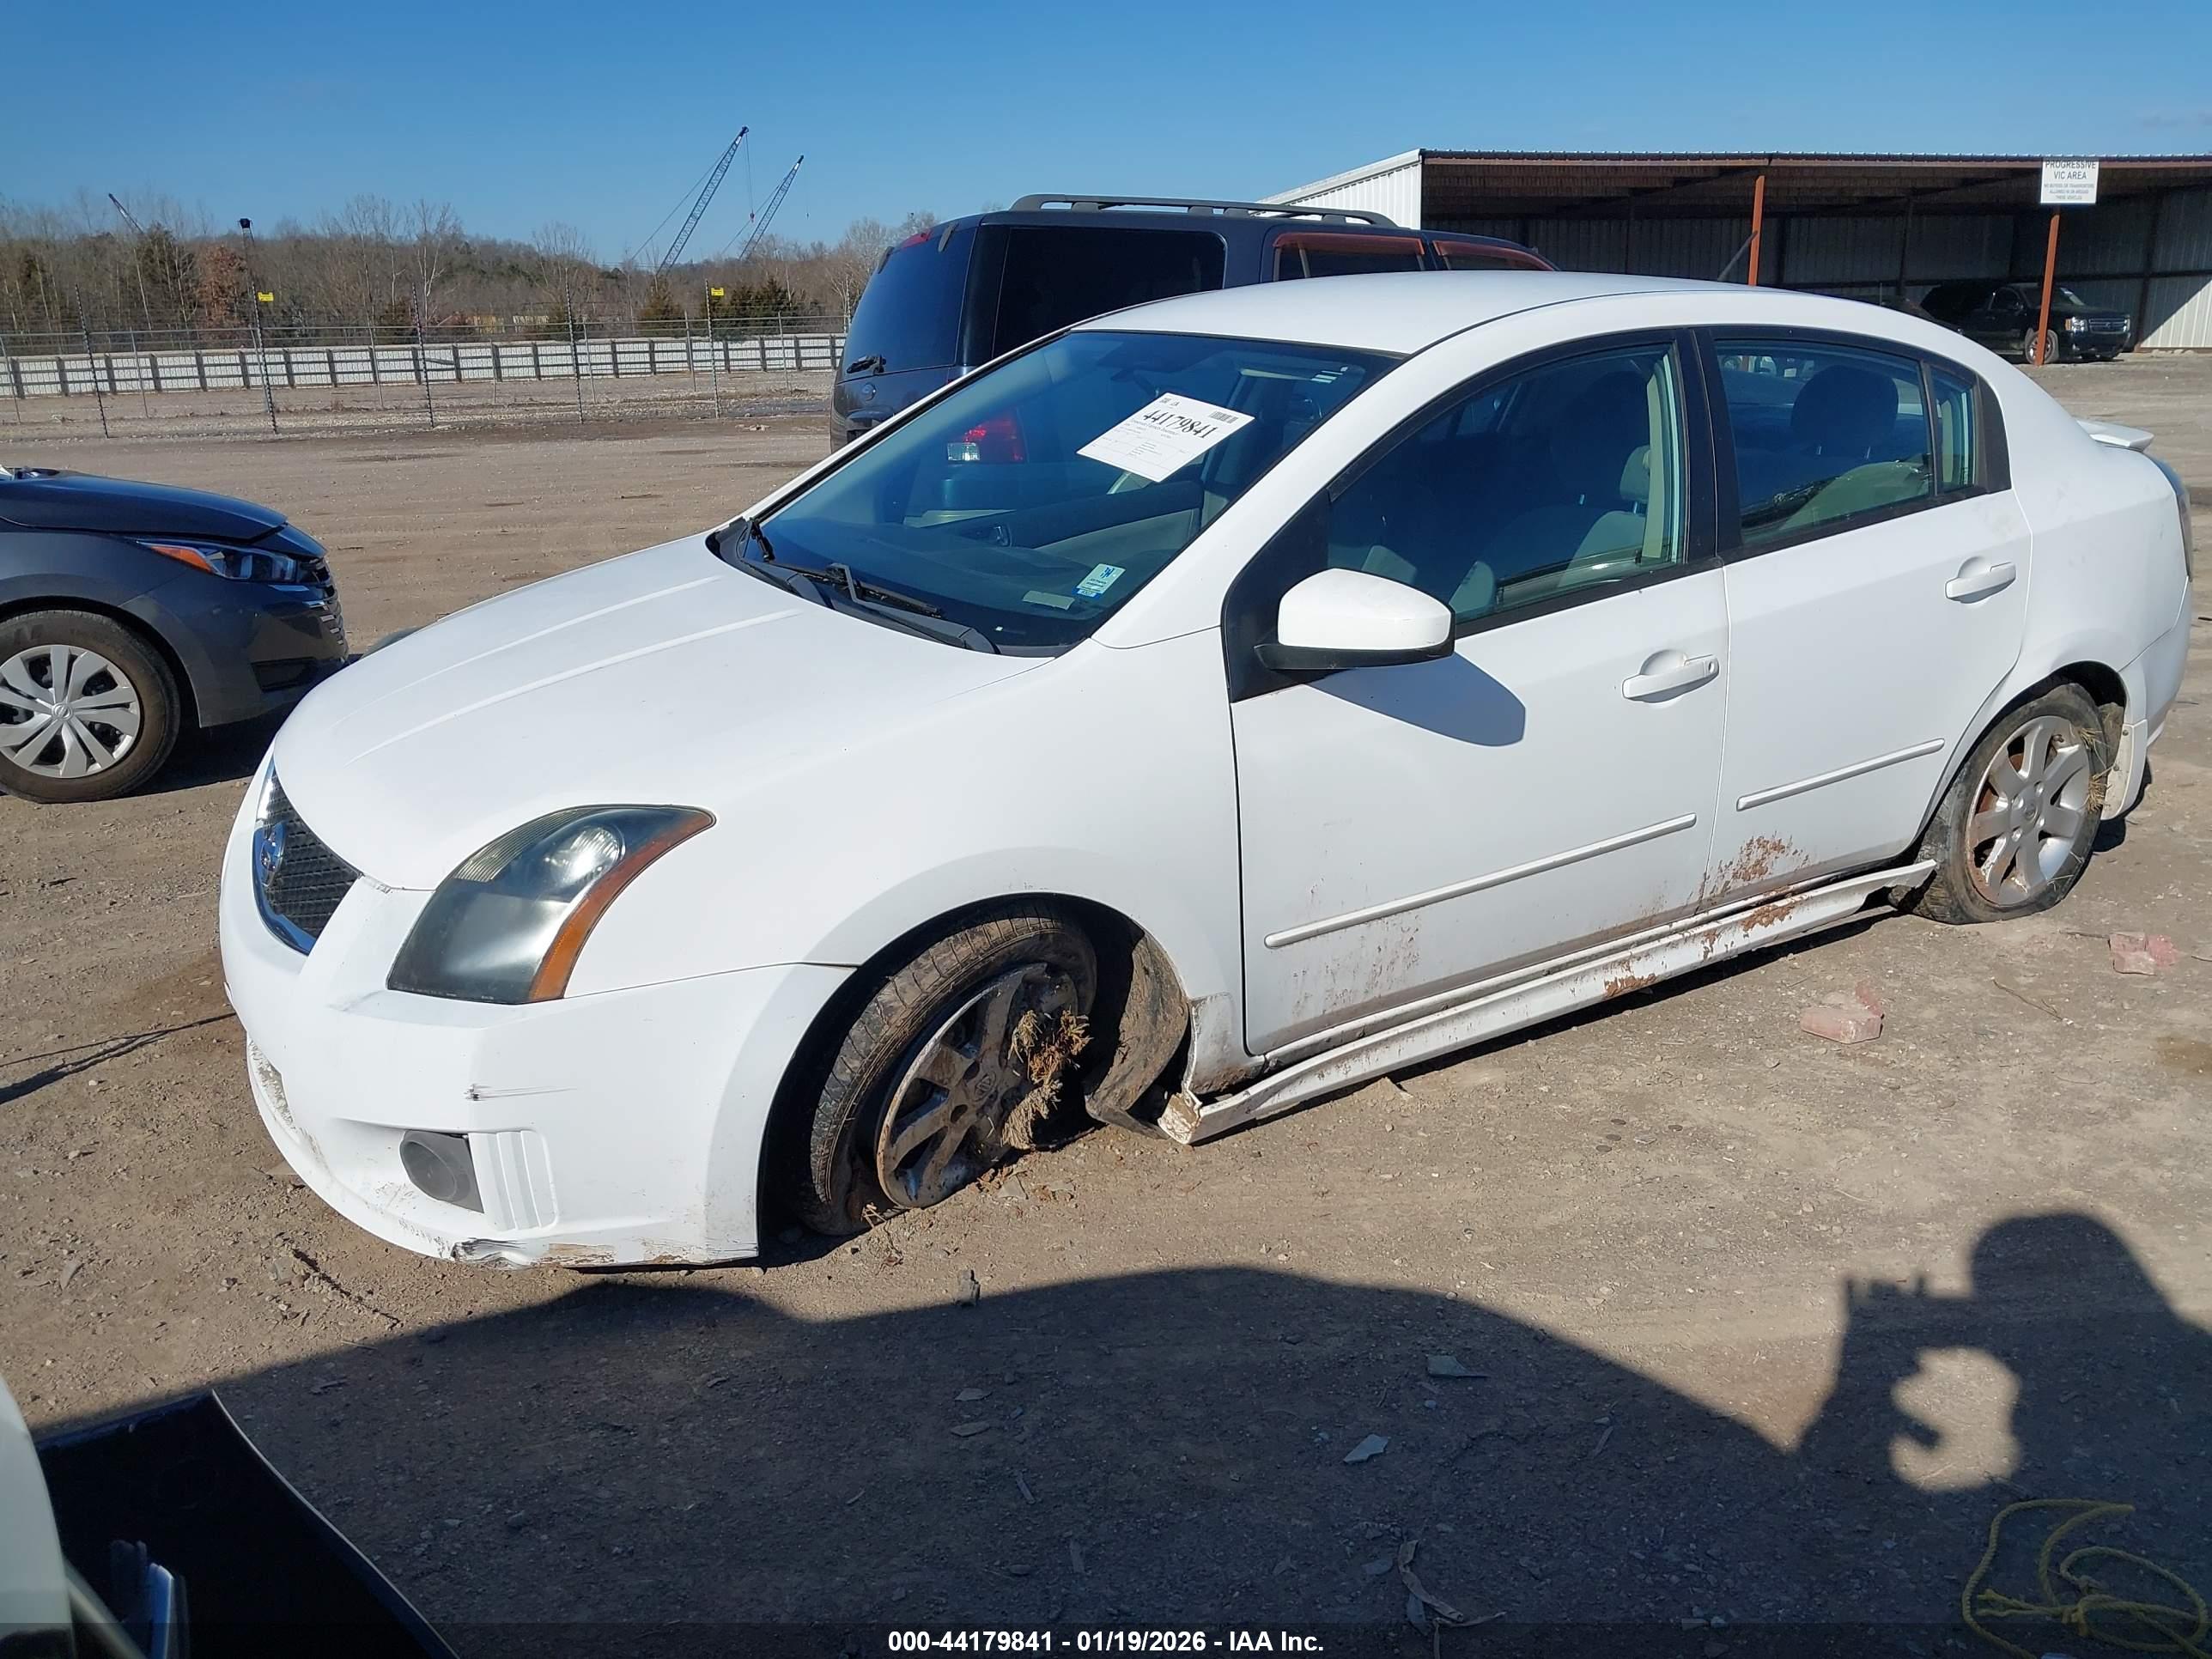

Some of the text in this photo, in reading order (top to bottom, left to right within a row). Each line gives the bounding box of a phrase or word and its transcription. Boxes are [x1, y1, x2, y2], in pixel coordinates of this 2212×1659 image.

[2045, 160, 2096, 169] PROGRESSIVE
[2053, 171, 2087, 179] VIC AREA
[1143, 410, 1218, 439] 44179841
